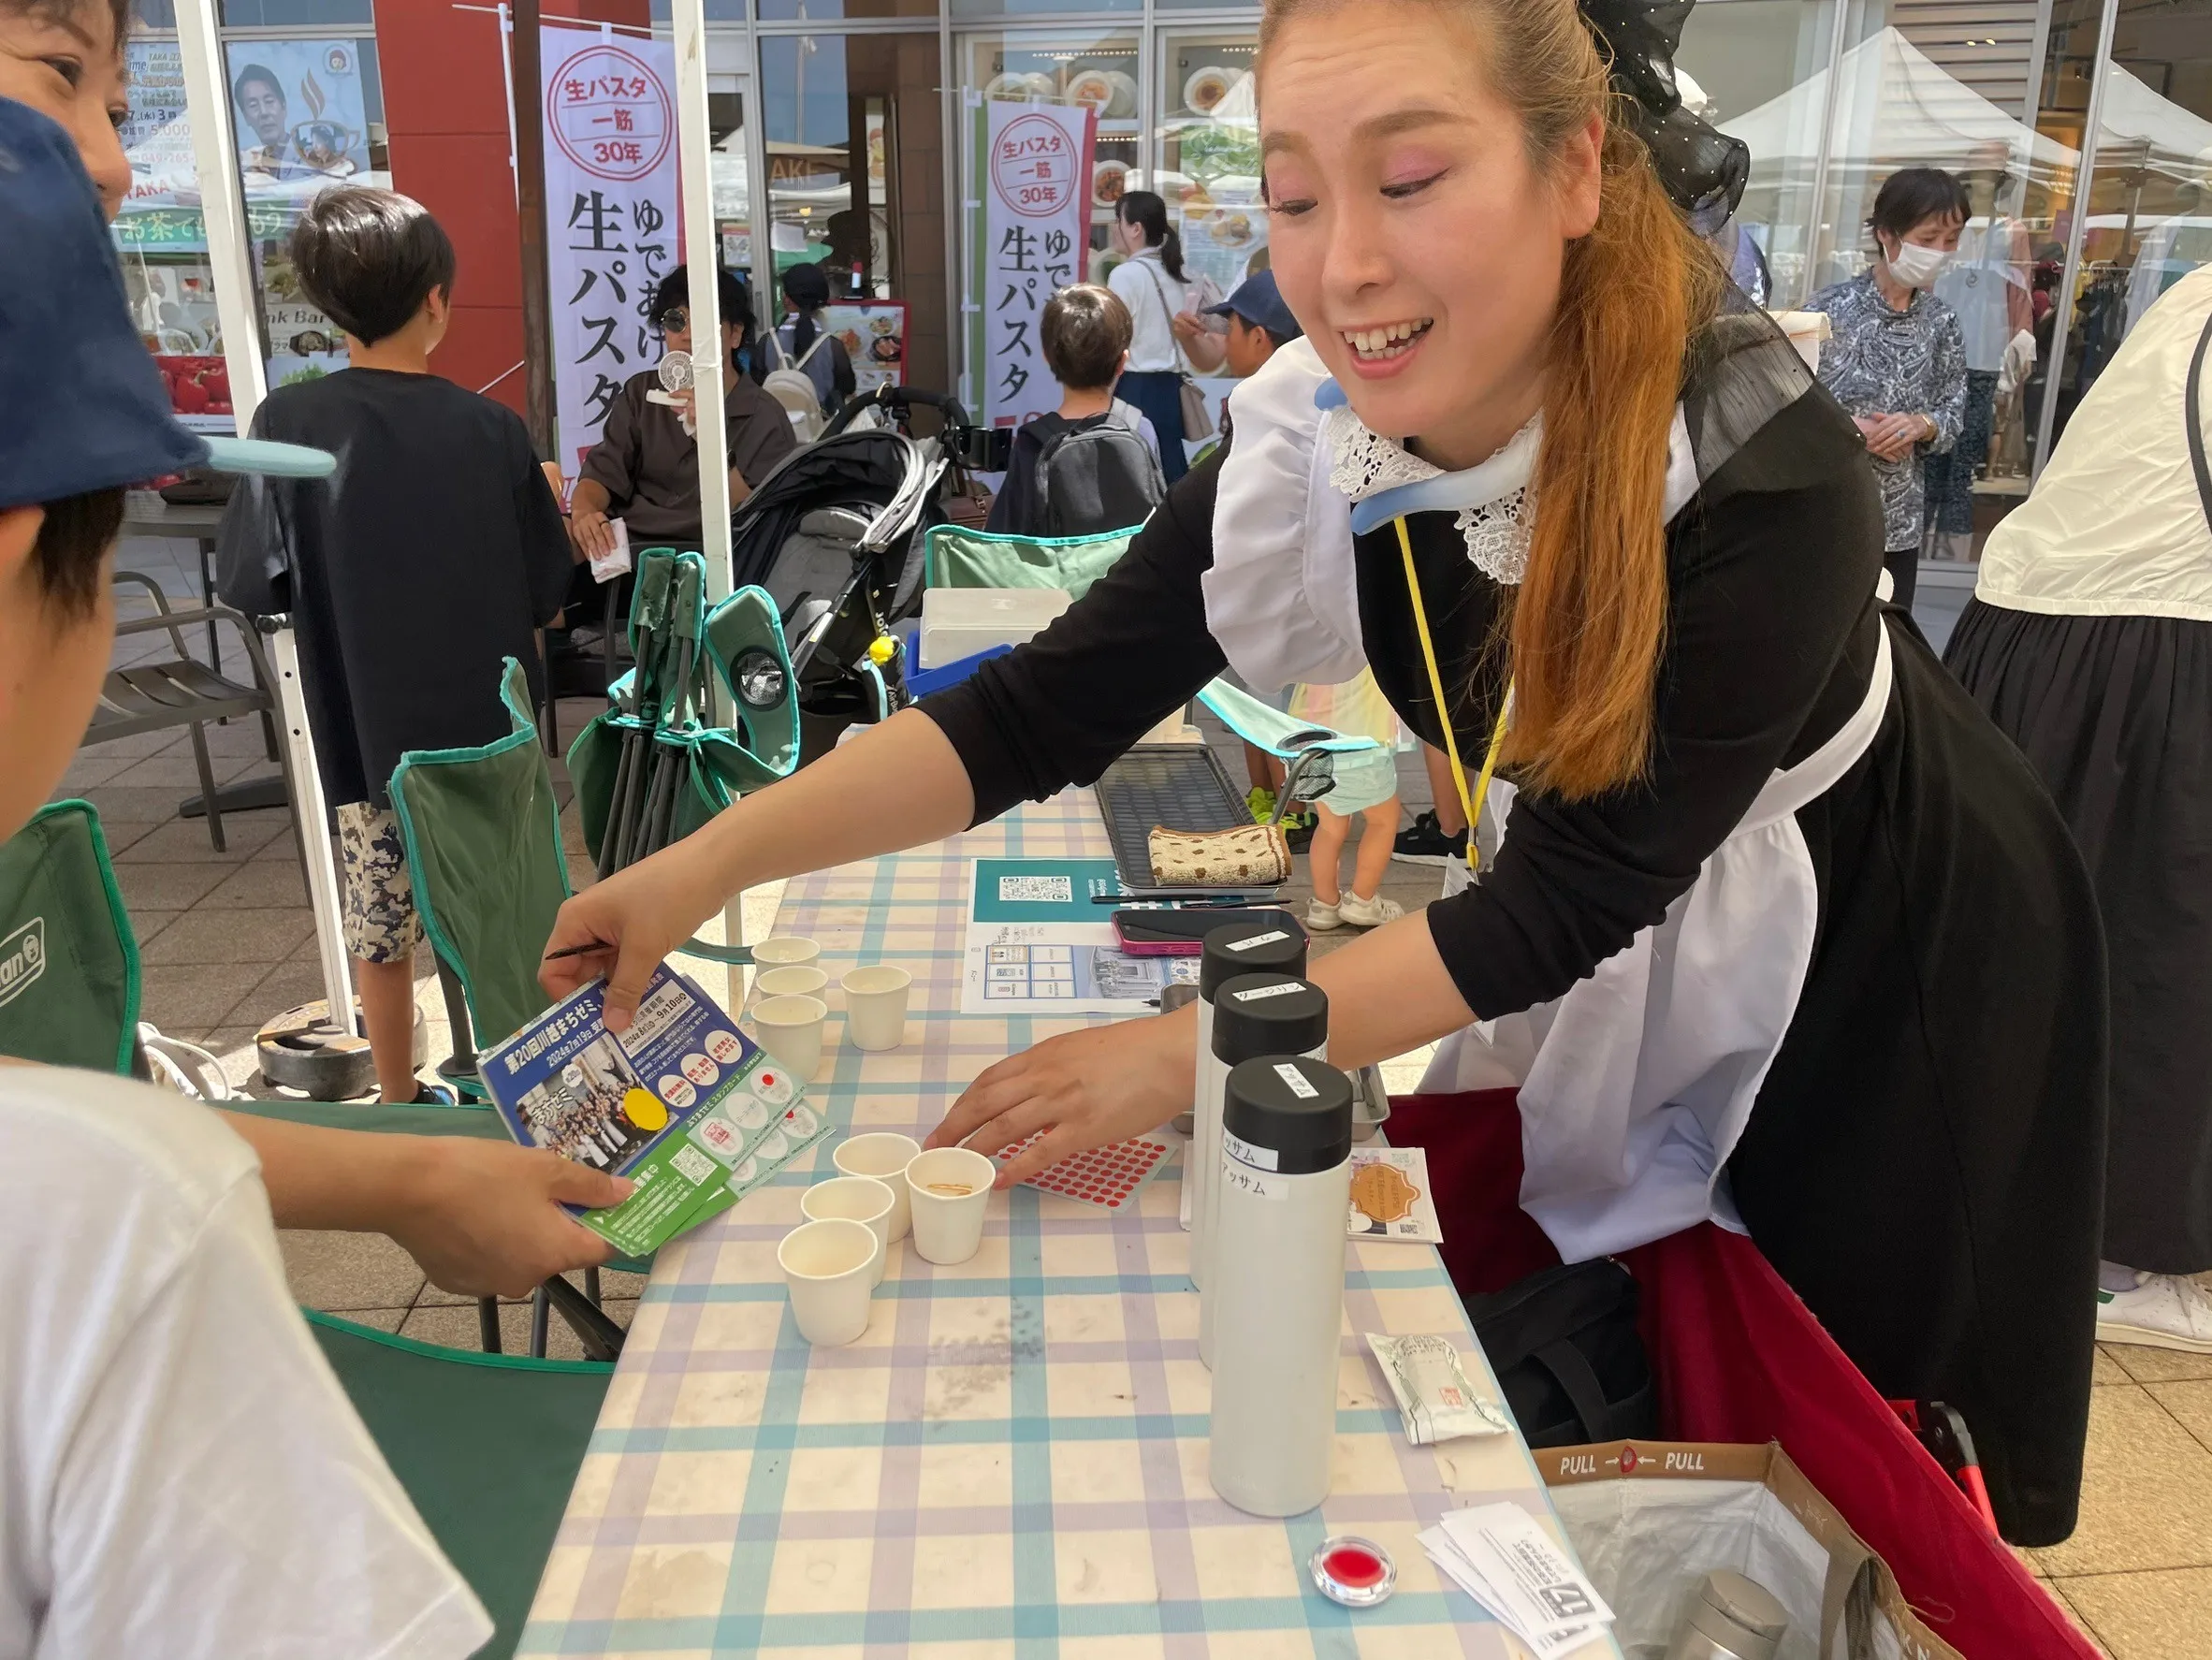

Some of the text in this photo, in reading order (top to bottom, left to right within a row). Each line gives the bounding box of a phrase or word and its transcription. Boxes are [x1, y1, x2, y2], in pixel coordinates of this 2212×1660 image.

[564, 77, 647, 102] 生パスタ
[591, 109, 633, 132] 一筋
[593, 141, 643, 164] 30年
[1019, 161, 1052, 179] 一筋
[1019, 186, 1058, 205] 30年
[1044, 228, 1071, 298] ゆで
[568, 190, 629, 428] 生パスタ
[996, 225, 1040, 404] 生パスタ
[503, 984, 608, 1075] 第20回川越まちゼミ、
[1224, 1136, 1256, 1163] ッサム
[1561, 1452, 1705, 1475] PULL PULL
